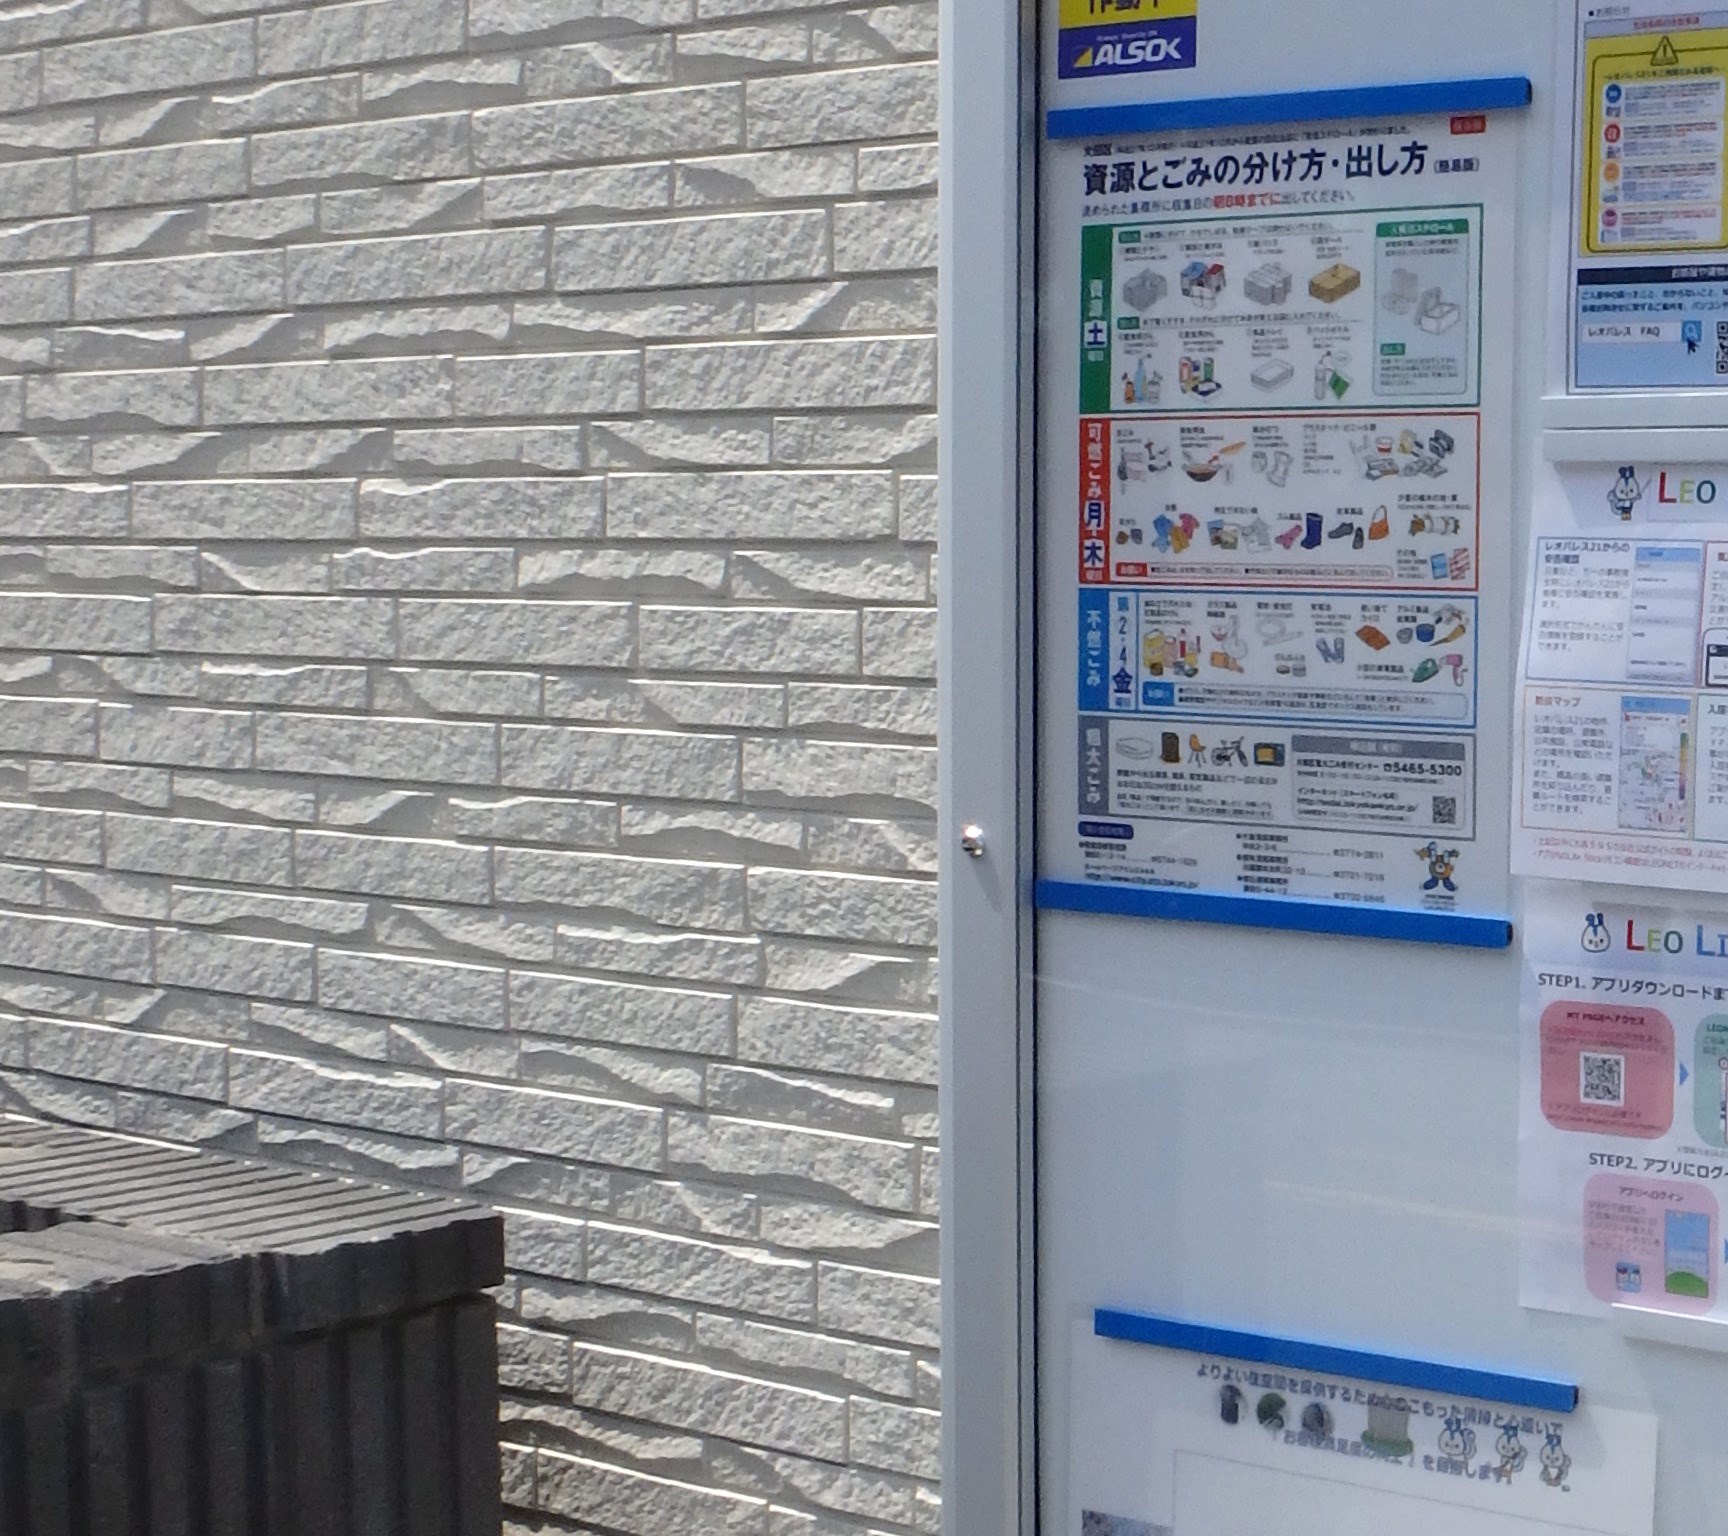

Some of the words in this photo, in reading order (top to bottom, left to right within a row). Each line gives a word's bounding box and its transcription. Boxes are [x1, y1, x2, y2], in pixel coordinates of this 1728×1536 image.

[1095, 37, 1182, 66] ALSOK
[1083, 140, 1429, 196] 資源とごみの分け方・出し方
[1588, 326, 1631, 336] レオパレス
[1640, 326, 1661, 336] FAQ
[1658, 472, 1716, 505] LEO
[1626, 919, 1683, 954] LEO
[1538, 972, 1587, 990] STEP1.
[1588, 1152, 1638, 1170] STEP2.
